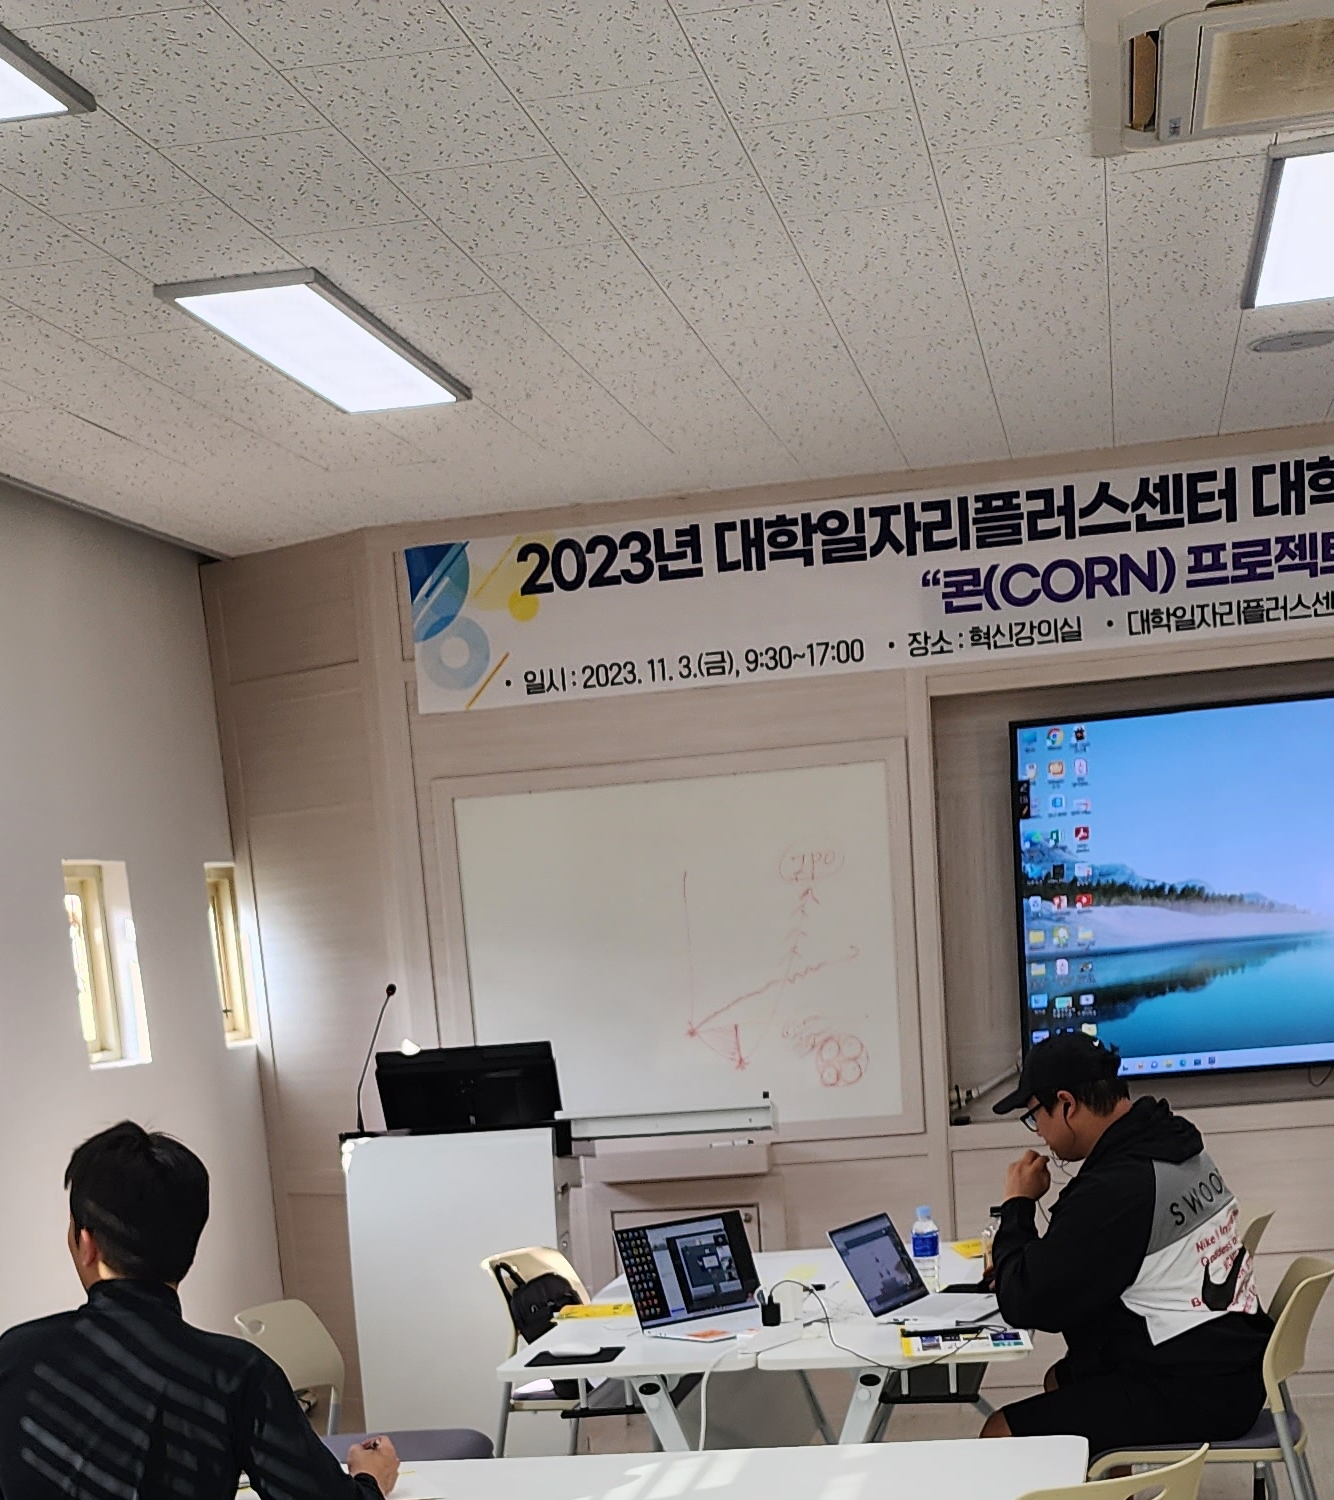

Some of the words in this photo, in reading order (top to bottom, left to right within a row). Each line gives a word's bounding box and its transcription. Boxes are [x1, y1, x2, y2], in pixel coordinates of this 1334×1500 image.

[516, 522, 704, 597] 2023년
[713, 466, 1238, 574] 대학일자리플러스센터
[744, 637, 865, 673] 9:30~17:00
[969, 615, 1083, 651] 혁신강의실
[1169, 1167, 1225, 1227] SWOO
